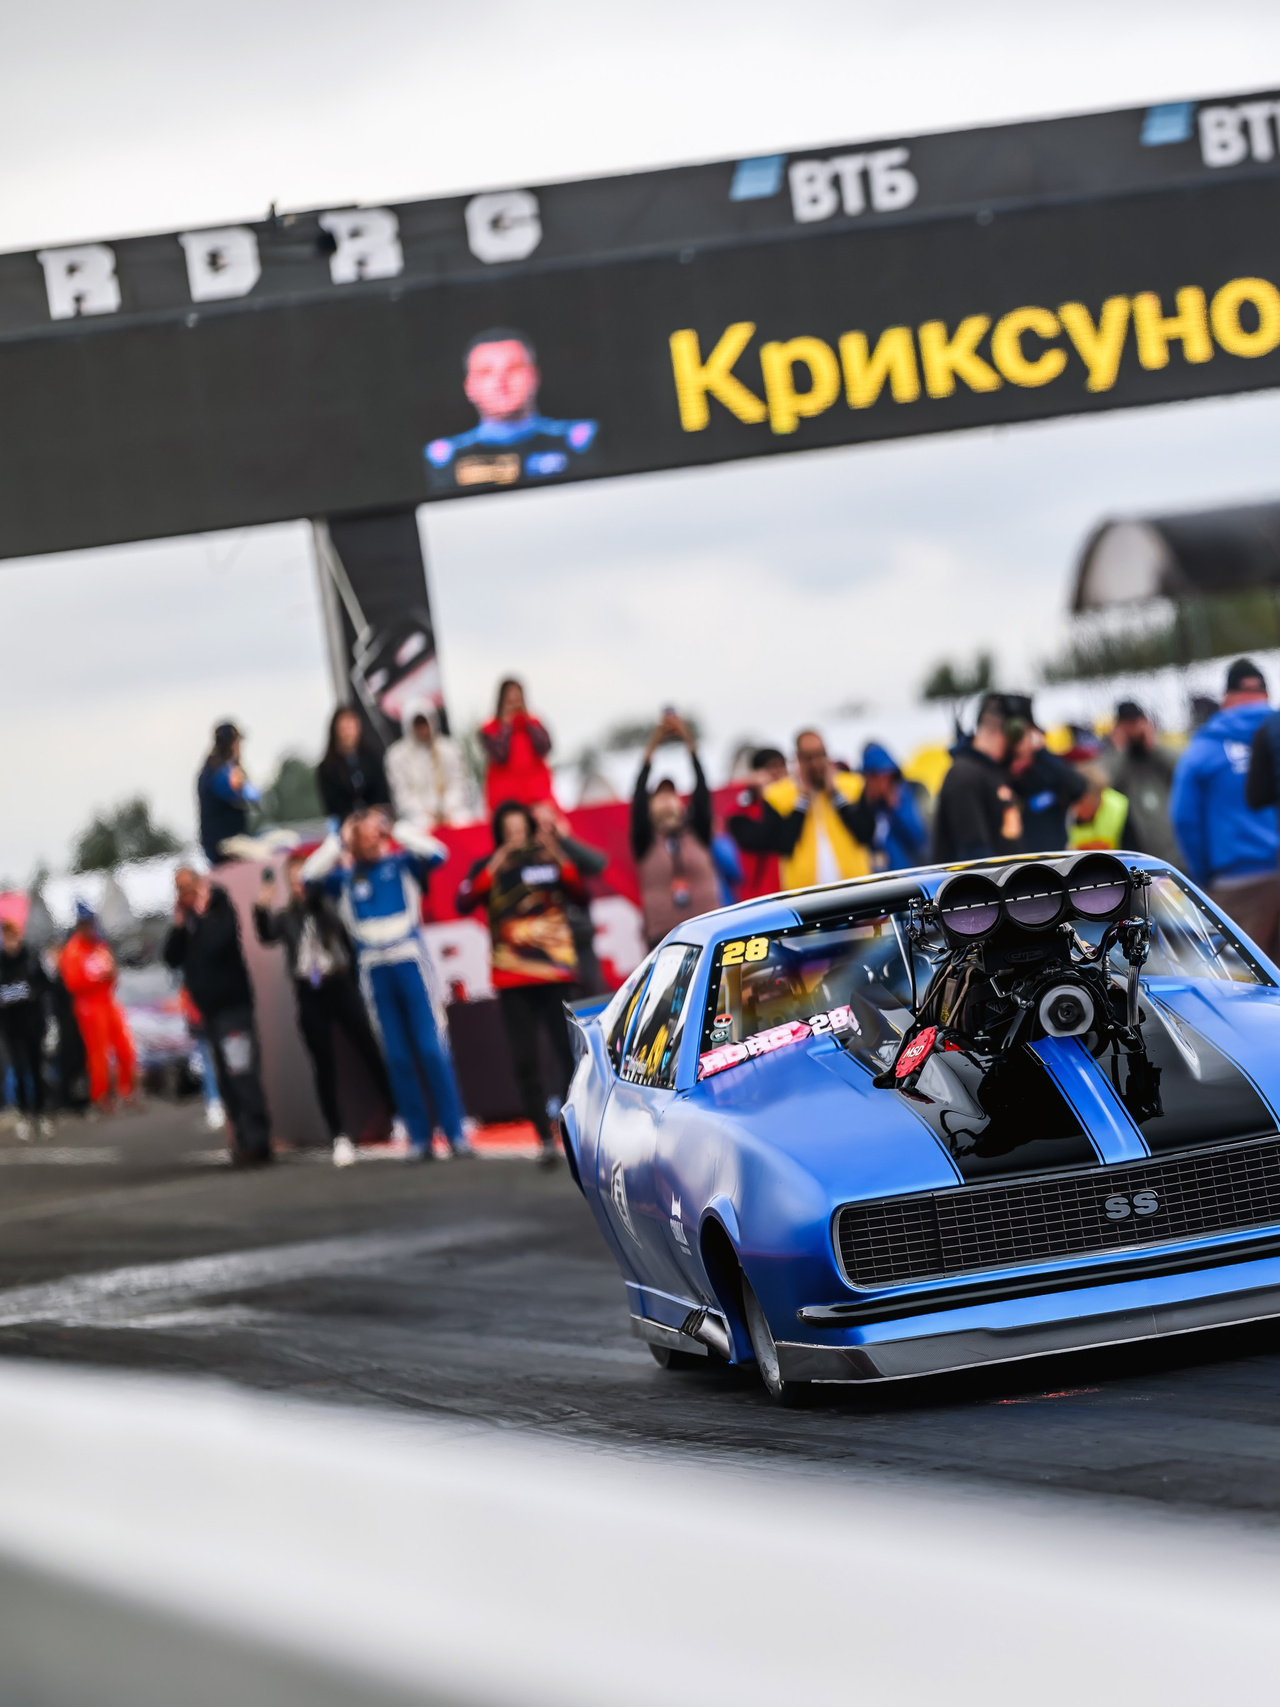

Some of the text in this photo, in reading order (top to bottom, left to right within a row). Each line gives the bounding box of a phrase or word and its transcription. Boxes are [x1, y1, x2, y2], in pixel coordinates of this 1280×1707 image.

[788, 147, 918, 224] ВТБ
[721, 937, 770, 966] 28
[809, 1009, 851, 1036] 28
[902, 1045, 924, 1059] MSD
[1105, 1192, 1158, 1219] SS
